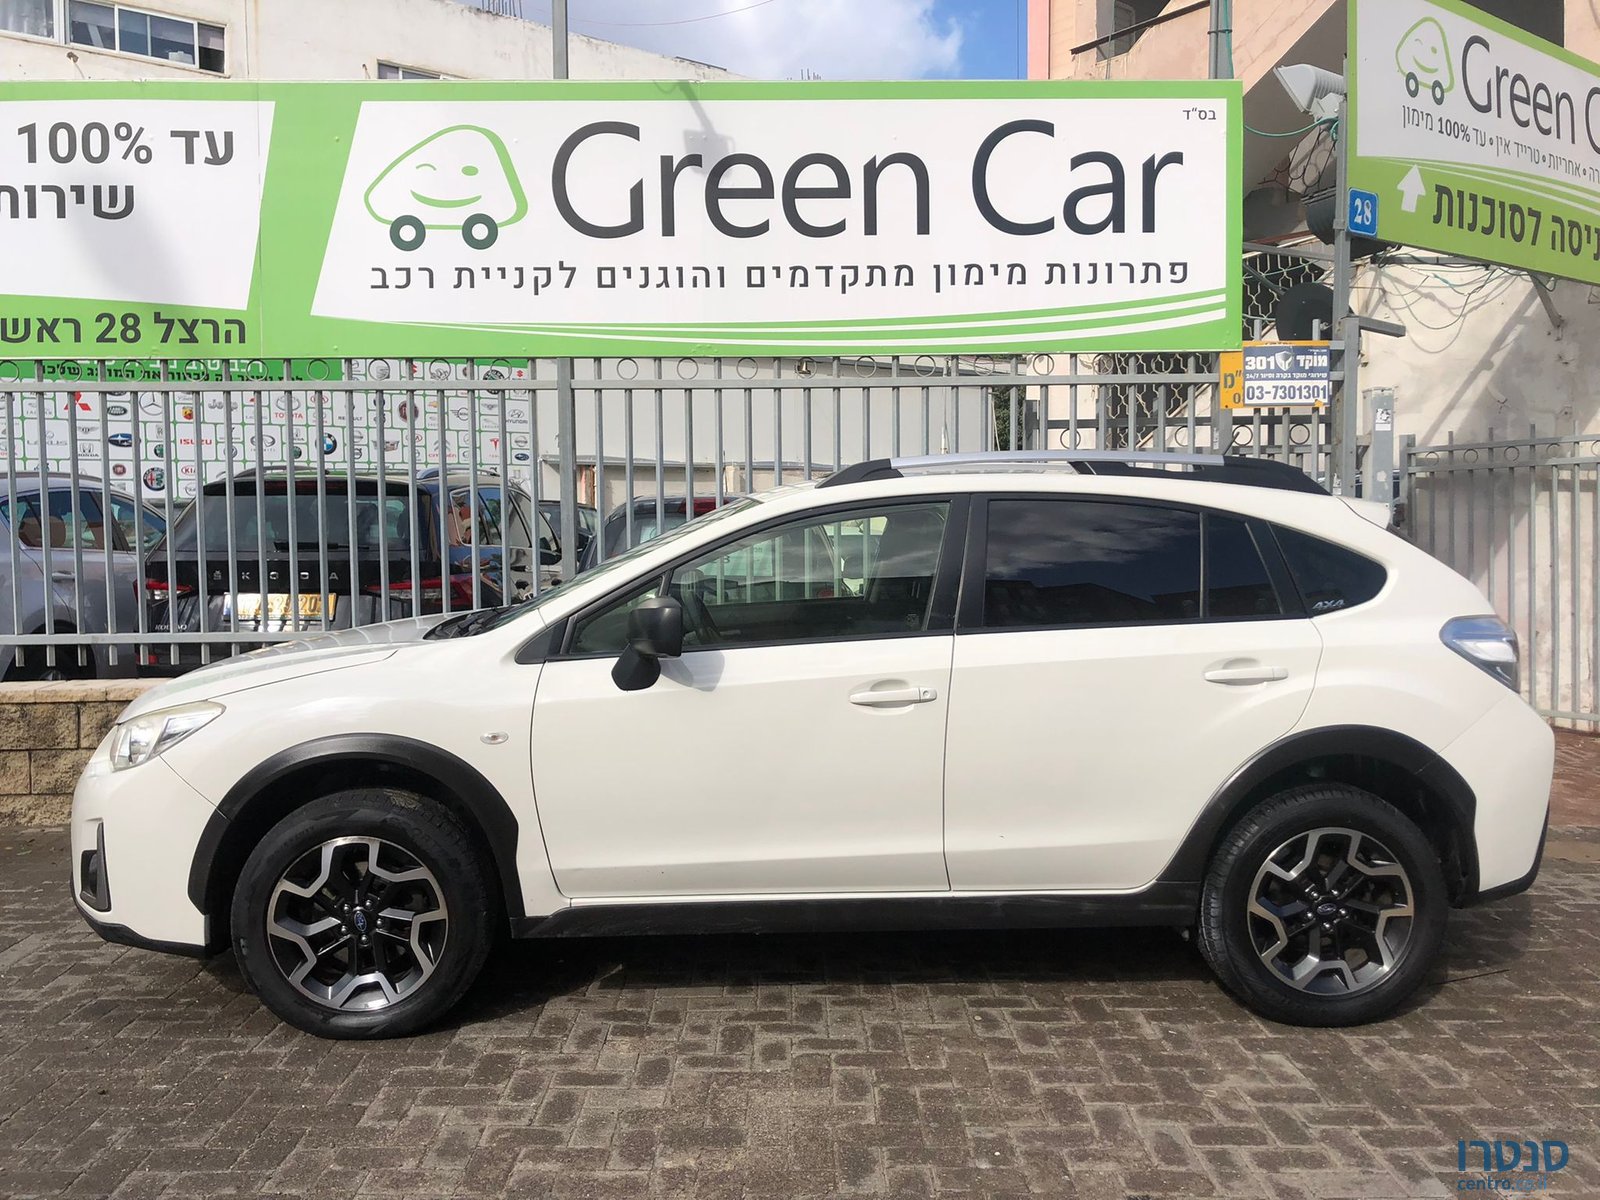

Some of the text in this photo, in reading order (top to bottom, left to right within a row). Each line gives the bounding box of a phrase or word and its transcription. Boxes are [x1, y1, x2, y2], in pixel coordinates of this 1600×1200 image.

[1461, 35, 1576, 144] Green
[1402, 104, 1434, 132] מימון
[1437, 116, 1471, 143] 100%
[17, 121, 234, 166] עד 100%
[1473, 127, 1487, 147] עד
[1495, 135, 1511, 157] אין
[551, 119, 1184, 239] Green Car
[1353, 197, 1372, 226] 28
[1432, 184, 1542, 247] לסוכנות
[369, 260, 1189, 296] פתרונות מימון מתקדמים והוגנים לקניית רכב
[94, 312, 142, 344] 28
[153, 311, 247, 345] הרצל
[1245, 356, 1275, 370] 301
[1246, 384, 1327, 401] 03-7301301
